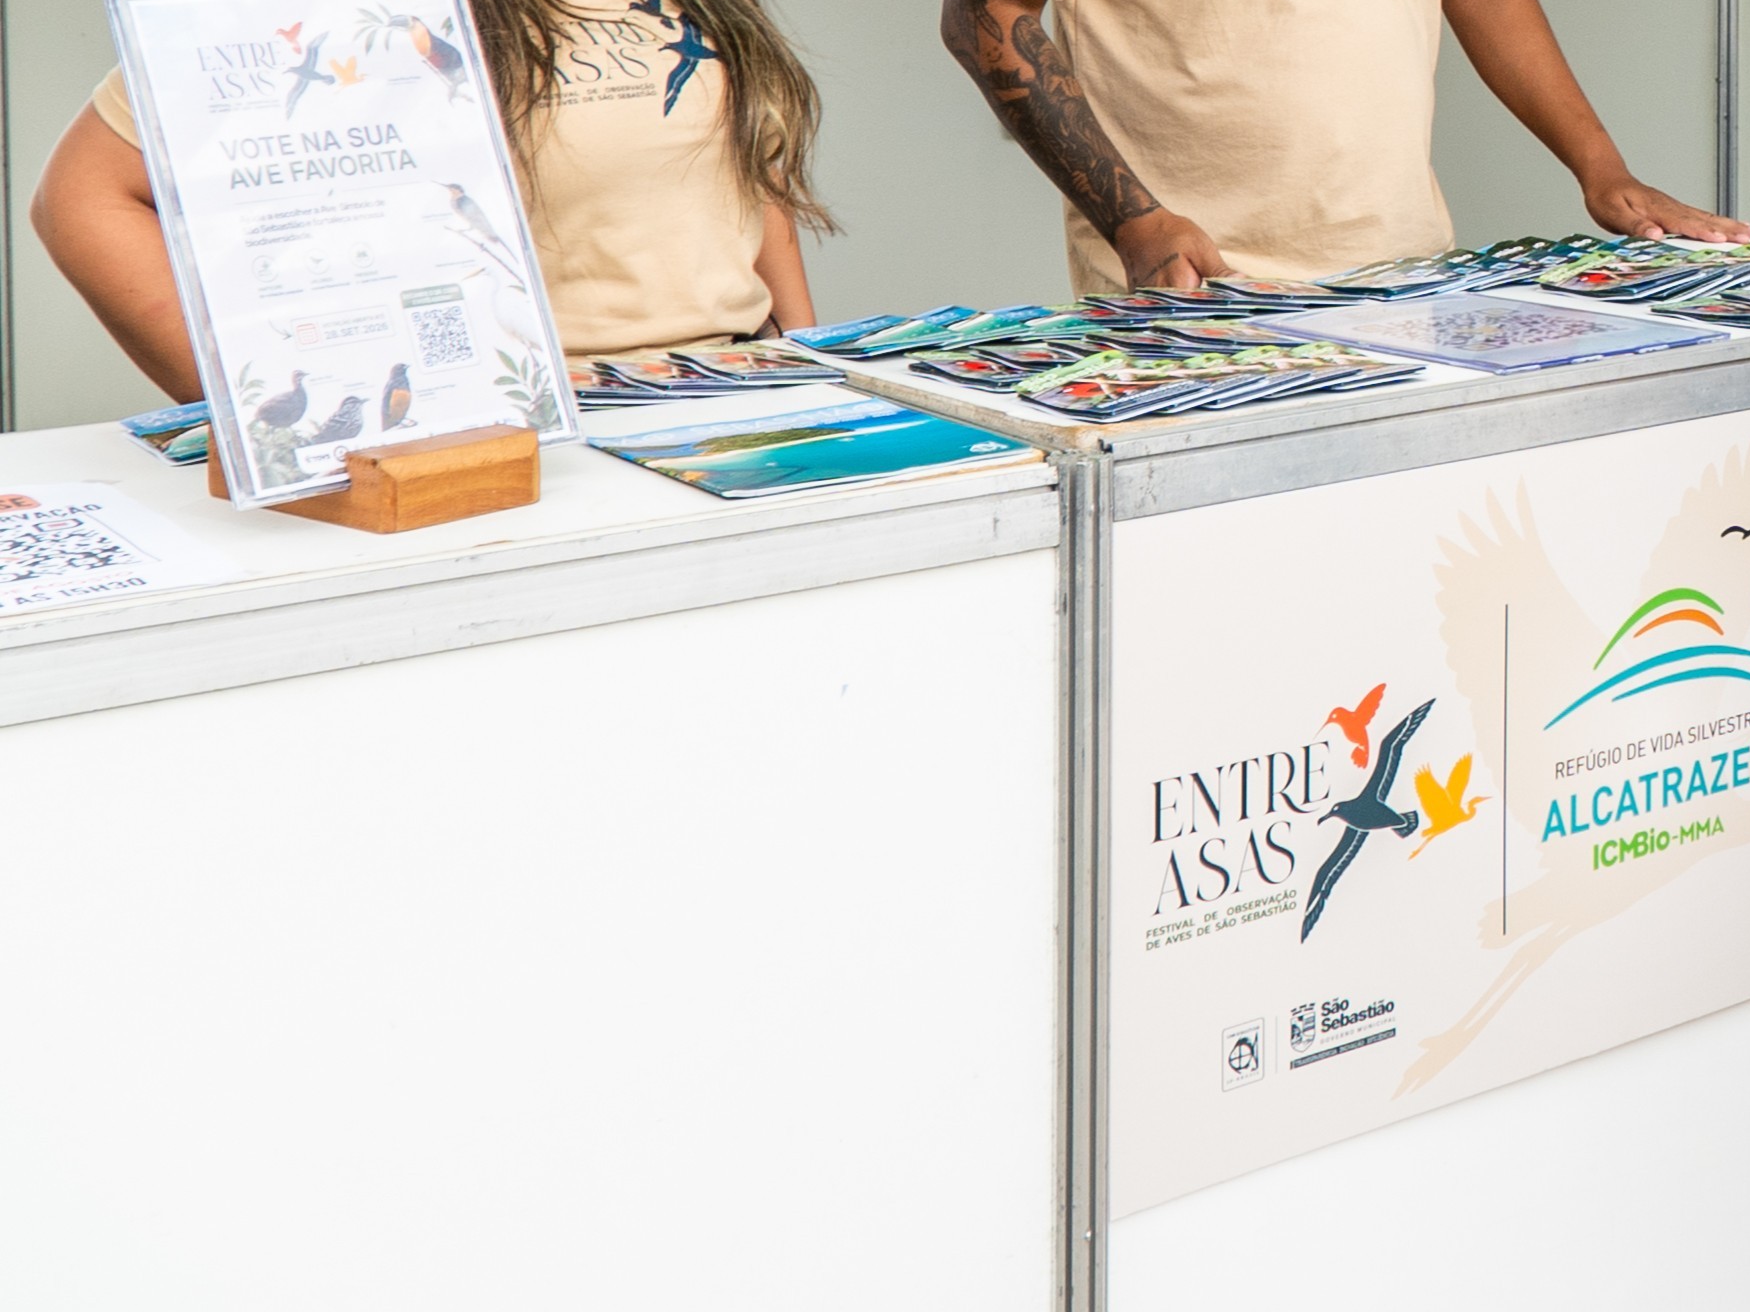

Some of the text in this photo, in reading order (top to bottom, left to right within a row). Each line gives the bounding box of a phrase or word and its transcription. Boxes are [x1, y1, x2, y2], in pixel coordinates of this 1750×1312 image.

[196, 41, 287, 72] ENTRE
[209, 70, 277, 101] ASAS
[219, 123, 403, 161] VOTE NA SUA
[229, 149, 418, 189] AVE FAVORITA
[1555, 747, 1622, 780] REFÚGIO
[1626, 739, 1647, 761] DE
[1650, 731, 1684, 753] VIDA
[1151, 741, 1331, 844] ENTRE
[1151, 820, 1296, 917] ASAS
[1146, 889, 1297, 938] FESTIVAL DE OBSERVAÇÃO
[1146, 900, 1297, 952] DE AVES DE SÃO SEBASTIÃO
[1321, 997, 1350, 1017] São
[1321, 999, 1396, 1033] Sebastião
